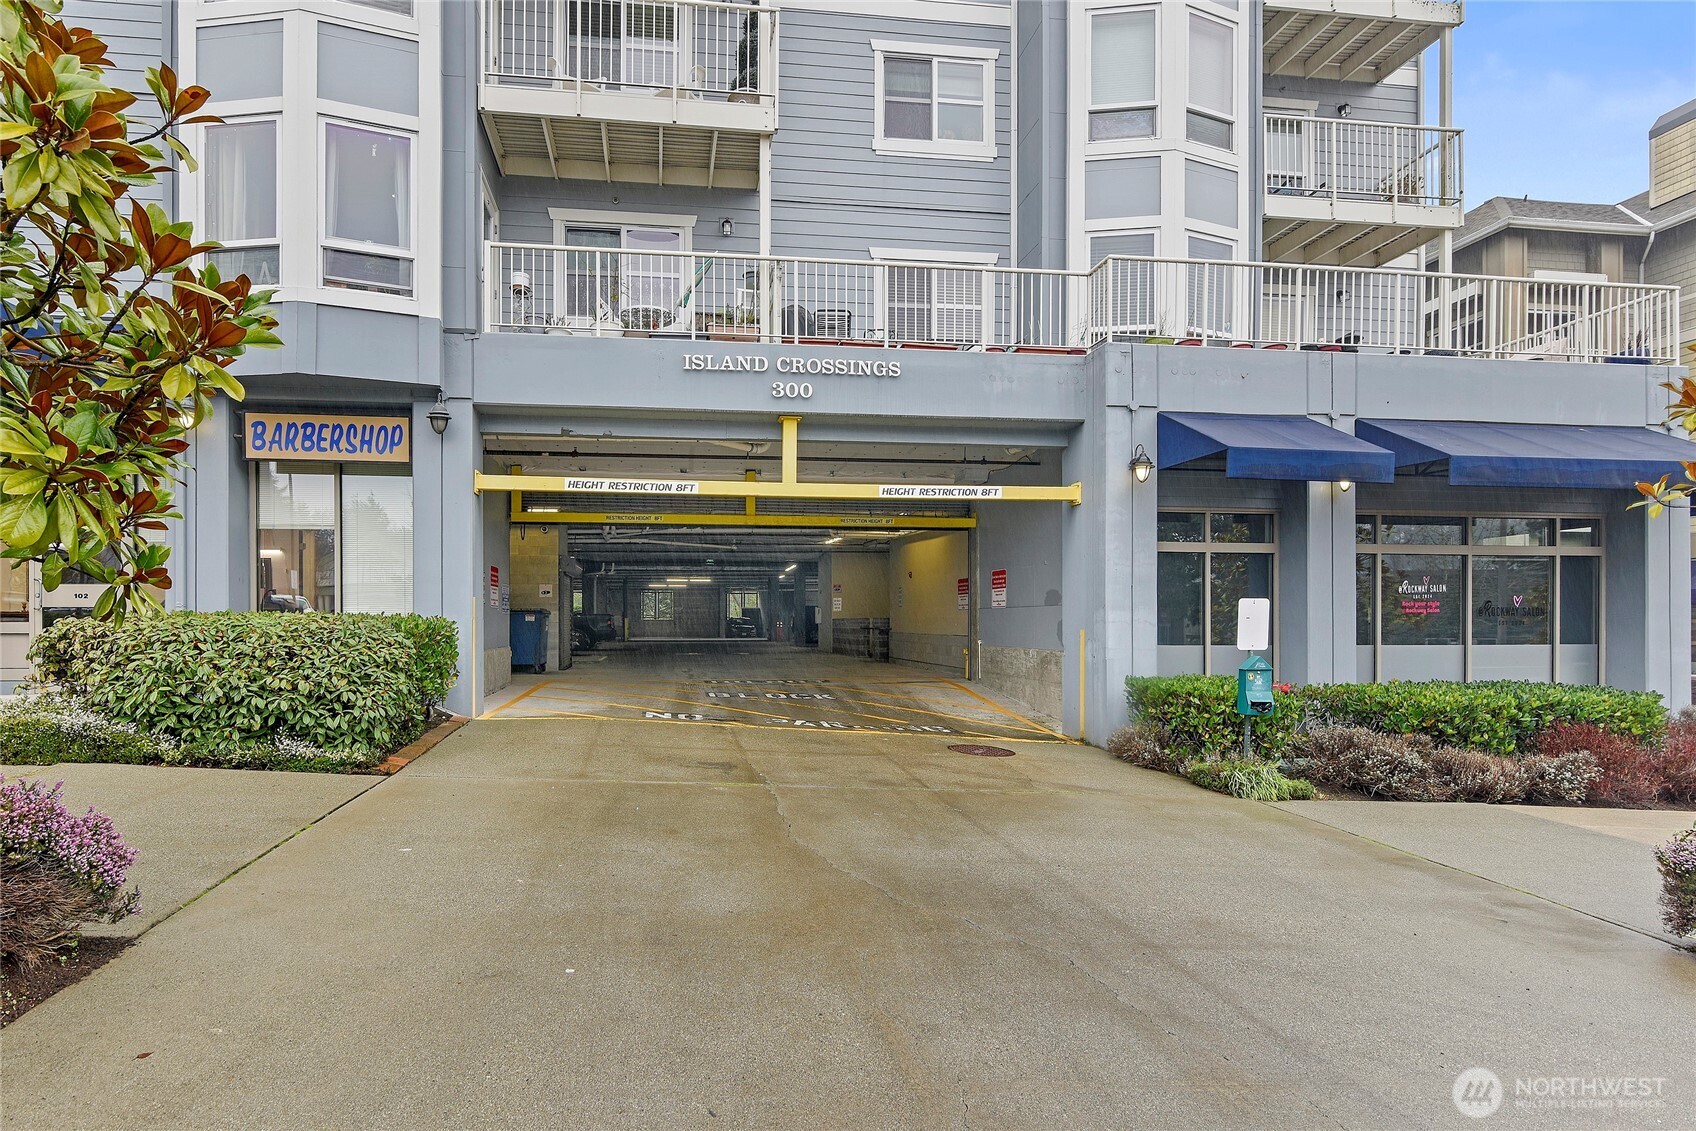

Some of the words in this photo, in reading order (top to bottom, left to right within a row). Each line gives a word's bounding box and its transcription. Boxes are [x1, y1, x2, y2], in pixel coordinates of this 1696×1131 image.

[683, 354, 769, 372] ISLAND
[776, 356, 901, 377] CROSSINGS
[772, 381, 813, 398] 300
[251, 420, 403, 455] BARBERSHOP
[567, 480, 605, 490] HEIGHT
[608, 481, 673, 492] RESTRICTION
[675, 483, 695, 492] 8FT
[882, 487, 916, 496] HEIGHT
[919, 487, 978, 497] RESTRICTION
[980, 488, 999, 497] 8FT
[1430, 584, 1447, 593] SALON
[1522, 607, 1545, 617] SALON
[707, 692, 837, 700] BLOCK
[643, 710, 704, 721] NO
